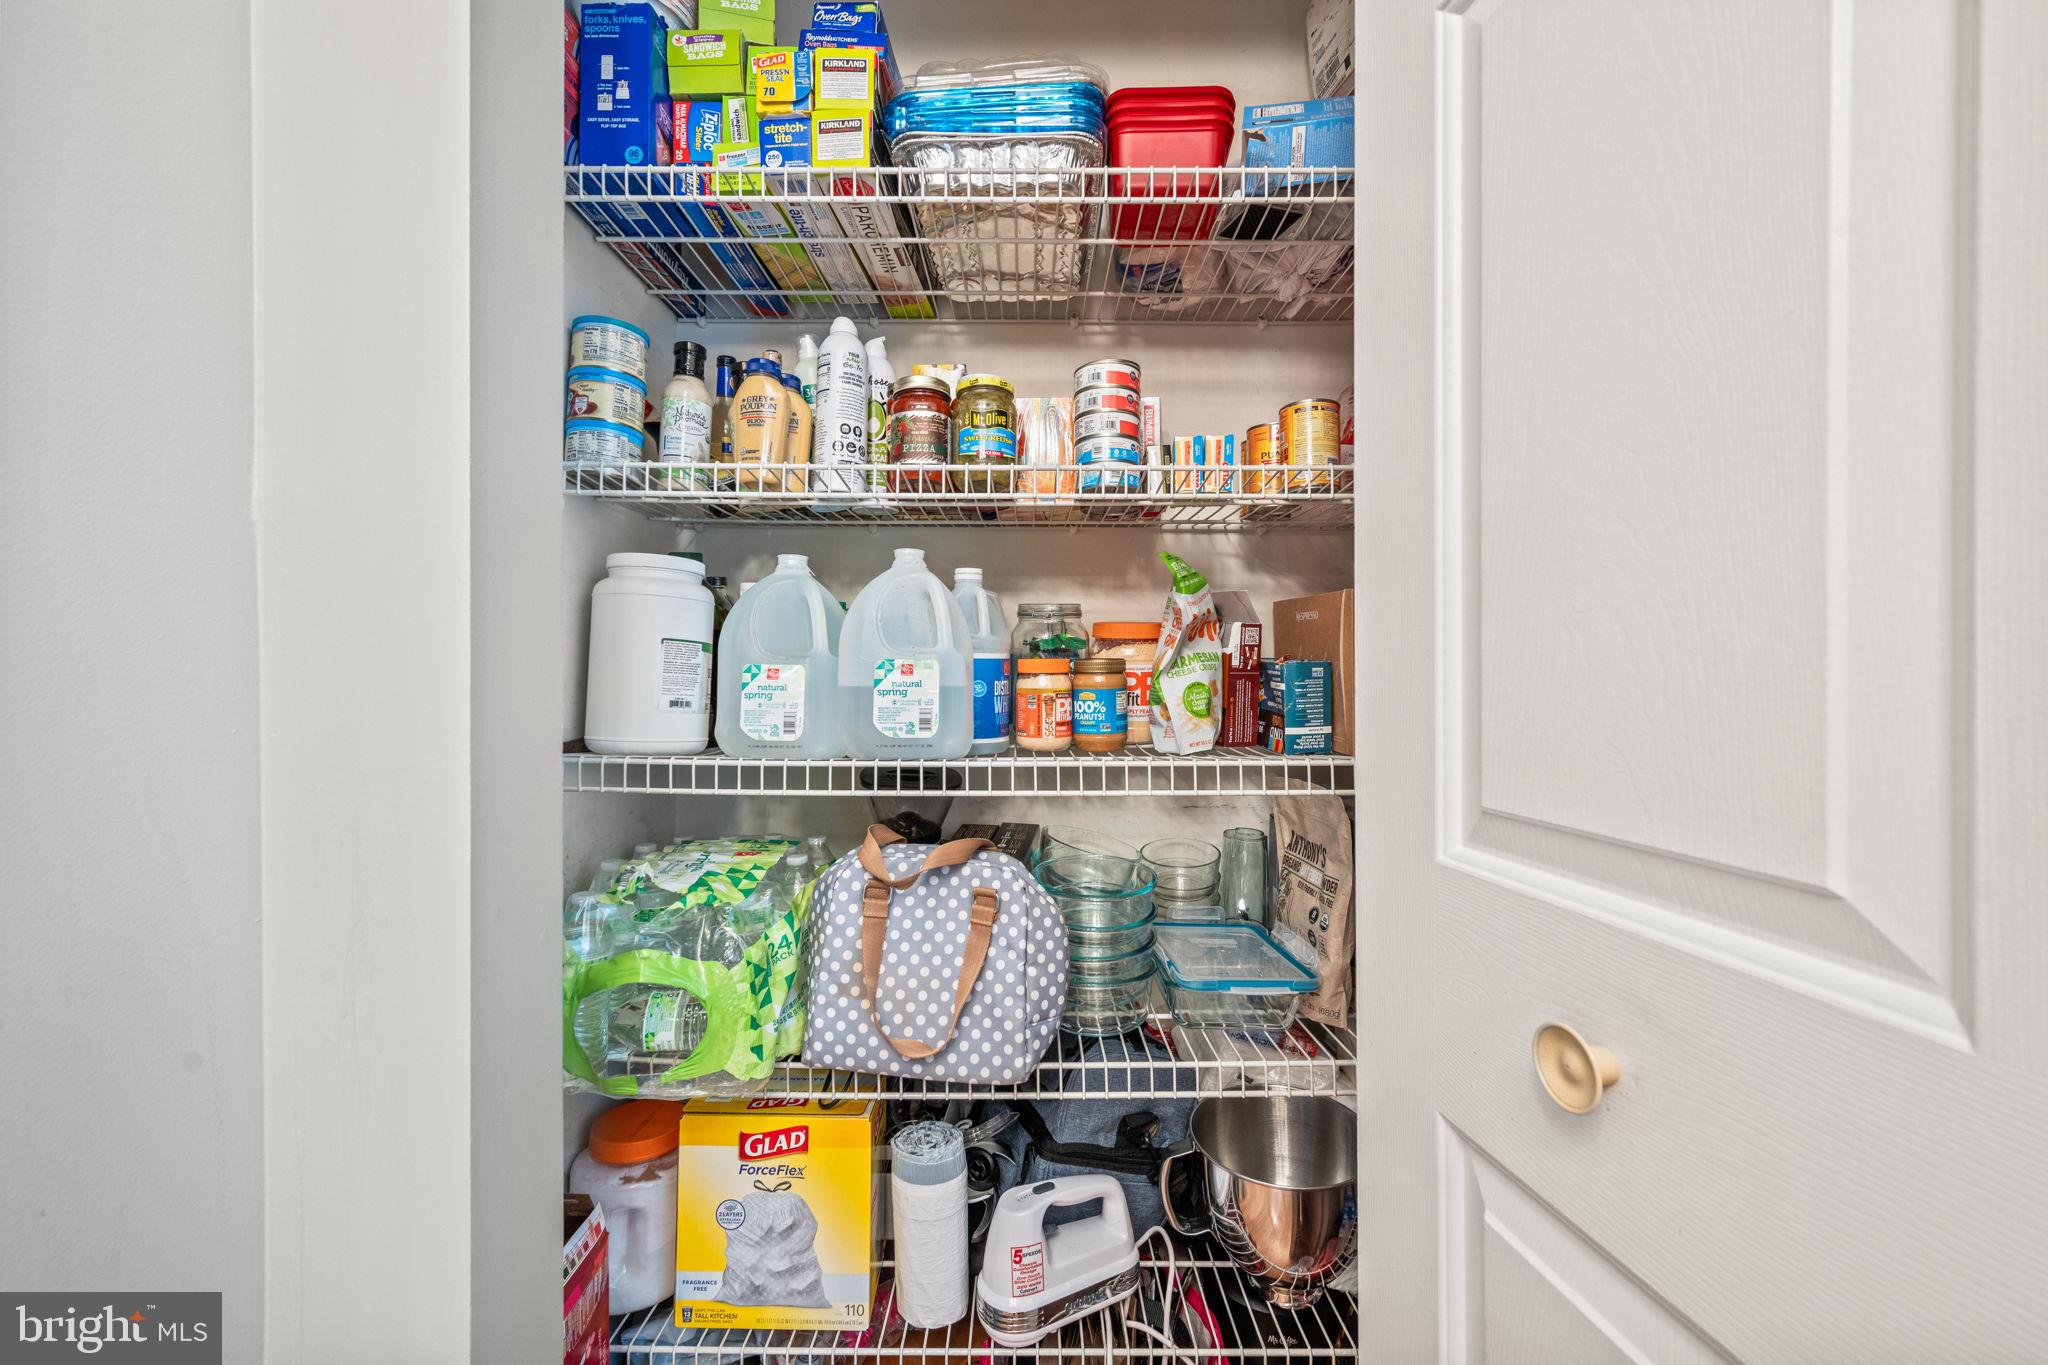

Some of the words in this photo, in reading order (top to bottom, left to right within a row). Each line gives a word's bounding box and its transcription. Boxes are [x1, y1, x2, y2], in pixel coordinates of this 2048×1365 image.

[585, 16, 612, 25] forks,
[613, 15, 647, 25] knives,
[814, 10, 837, 21] Oven
[838, 12, 862, 26] Bags
[585, 25, 620, 34] spoons
[683, 42, 726, 53] SANDWICH
[687, 52, 724, 60] BAGS
[759, 55, 785, 67] GLAD
[825, 60, 866, 68] KIRKLAND
[763, 87, 776, 96] 70
[734, 109, 742, 141] sandwich
[764, 122, 808, 134] stretch-
[821, 121, 861, 129] KIRKLAND
[700, 113, 719, 151] Ziploc
[695, 127, 703, 152] Slider
[774, 133, 793, 144] tite
[629, 150, 639, 158] 96
[675, 150, 683, 160] 20
[741, 403, 777, 411] POUPON
[986, 412, 1007, 425] Olive
[964, 436, 988, 444] SWEET
[991, 436, 1013, 445] RELISH
[903, 444, 936, 452] PIZZA
[1296, 611, 1319, 621] NESPRESSO
[1167, 666, 1198, 678] CHEESE
[892, 680, 923, 688] natural
[744, 691, 773, 701] spring
[877, 688, 908, 698] spring
[1127, 691, 1140, 707] fit
[1074, 700, 1106, 713] 100%
[1287, 830, 1327, 868] ANTHONY'S
[1282, 854, 1301, 873] ORGANIC
[768, 933, 793, 959] 24
[772, 949, 794, 966] PACK
[744, 1131, 806, 1158] GLAD
[739, 1164, 807, 1179] ForceFlex
[1013, 1249, 1022, 1265] 5
[845, 1304, 865, 1317] 110
